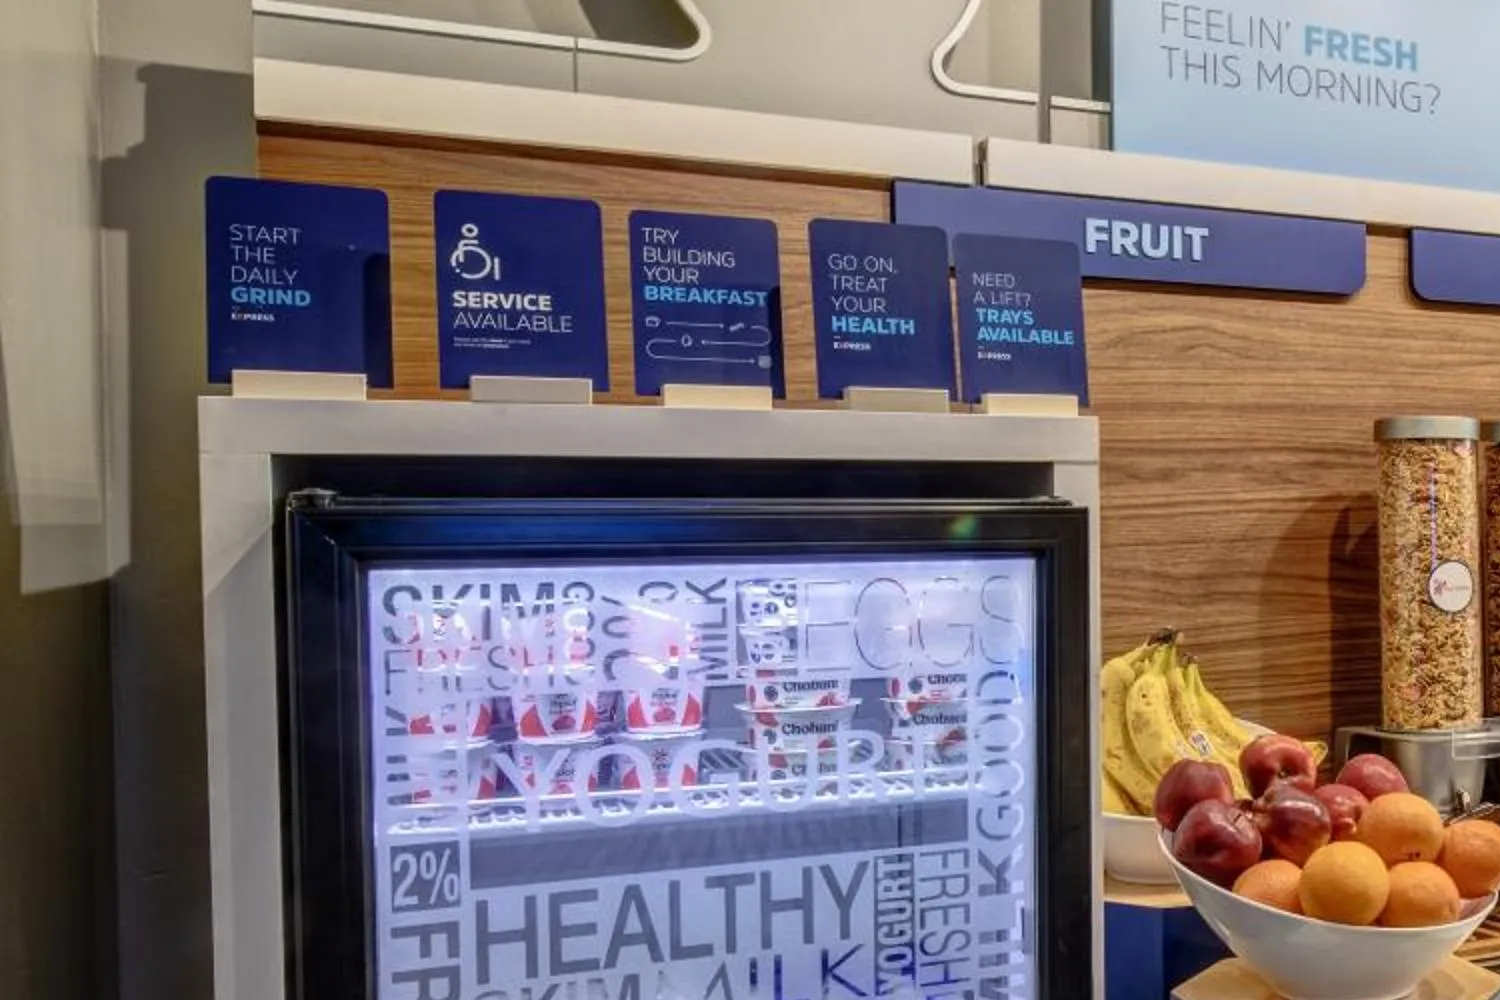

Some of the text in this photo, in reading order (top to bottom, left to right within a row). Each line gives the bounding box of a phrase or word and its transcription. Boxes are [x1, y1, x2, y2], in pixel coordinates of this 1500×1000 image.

[1160, 1, 1419, 72] FEELIN' FRESH
[1160, 45, 1442, 115] THIS MORNING?
[229, 223, 302, 246] START
[642, 226, 679, 245] TRY
[1085, 217, 1209, 261] FRUIT
[231, 245, 276, 265] THE
[643, 247, 735, 269] BUILDING
[828, 253, 857, 272] GO
[231, 266, 299, 287] DAILY
[643, 264, 700, 284] YOUR
[830, 274, 888, 294] TREAT
[972, 272, 1016, 289] NEED
[231, 286, 311, 308] GRIND
[452, 290, 552, 312] SERVICE
[643, 284, 769, 308] BREAKFAST
[831, 295, 887, 314] YOUR
[973, 290, 986, 305] A
[453, 310, 573, 334] AVAILABLE
[831, 315, 916, 336] HEALTH
[976, 307, 1035, 326] TRAYS
[976, 325, 1076, 345] AVAILABLE
[382, 581, 556, 645] SKIM
[684, 576, 728, 682] MILK
[393, 848, 459, 907] 2%
[475, 858, 871, 986] HEALTHY
[875, 852, 916, 997] YOGURT
[919, 847, 972, 990] FRESH
